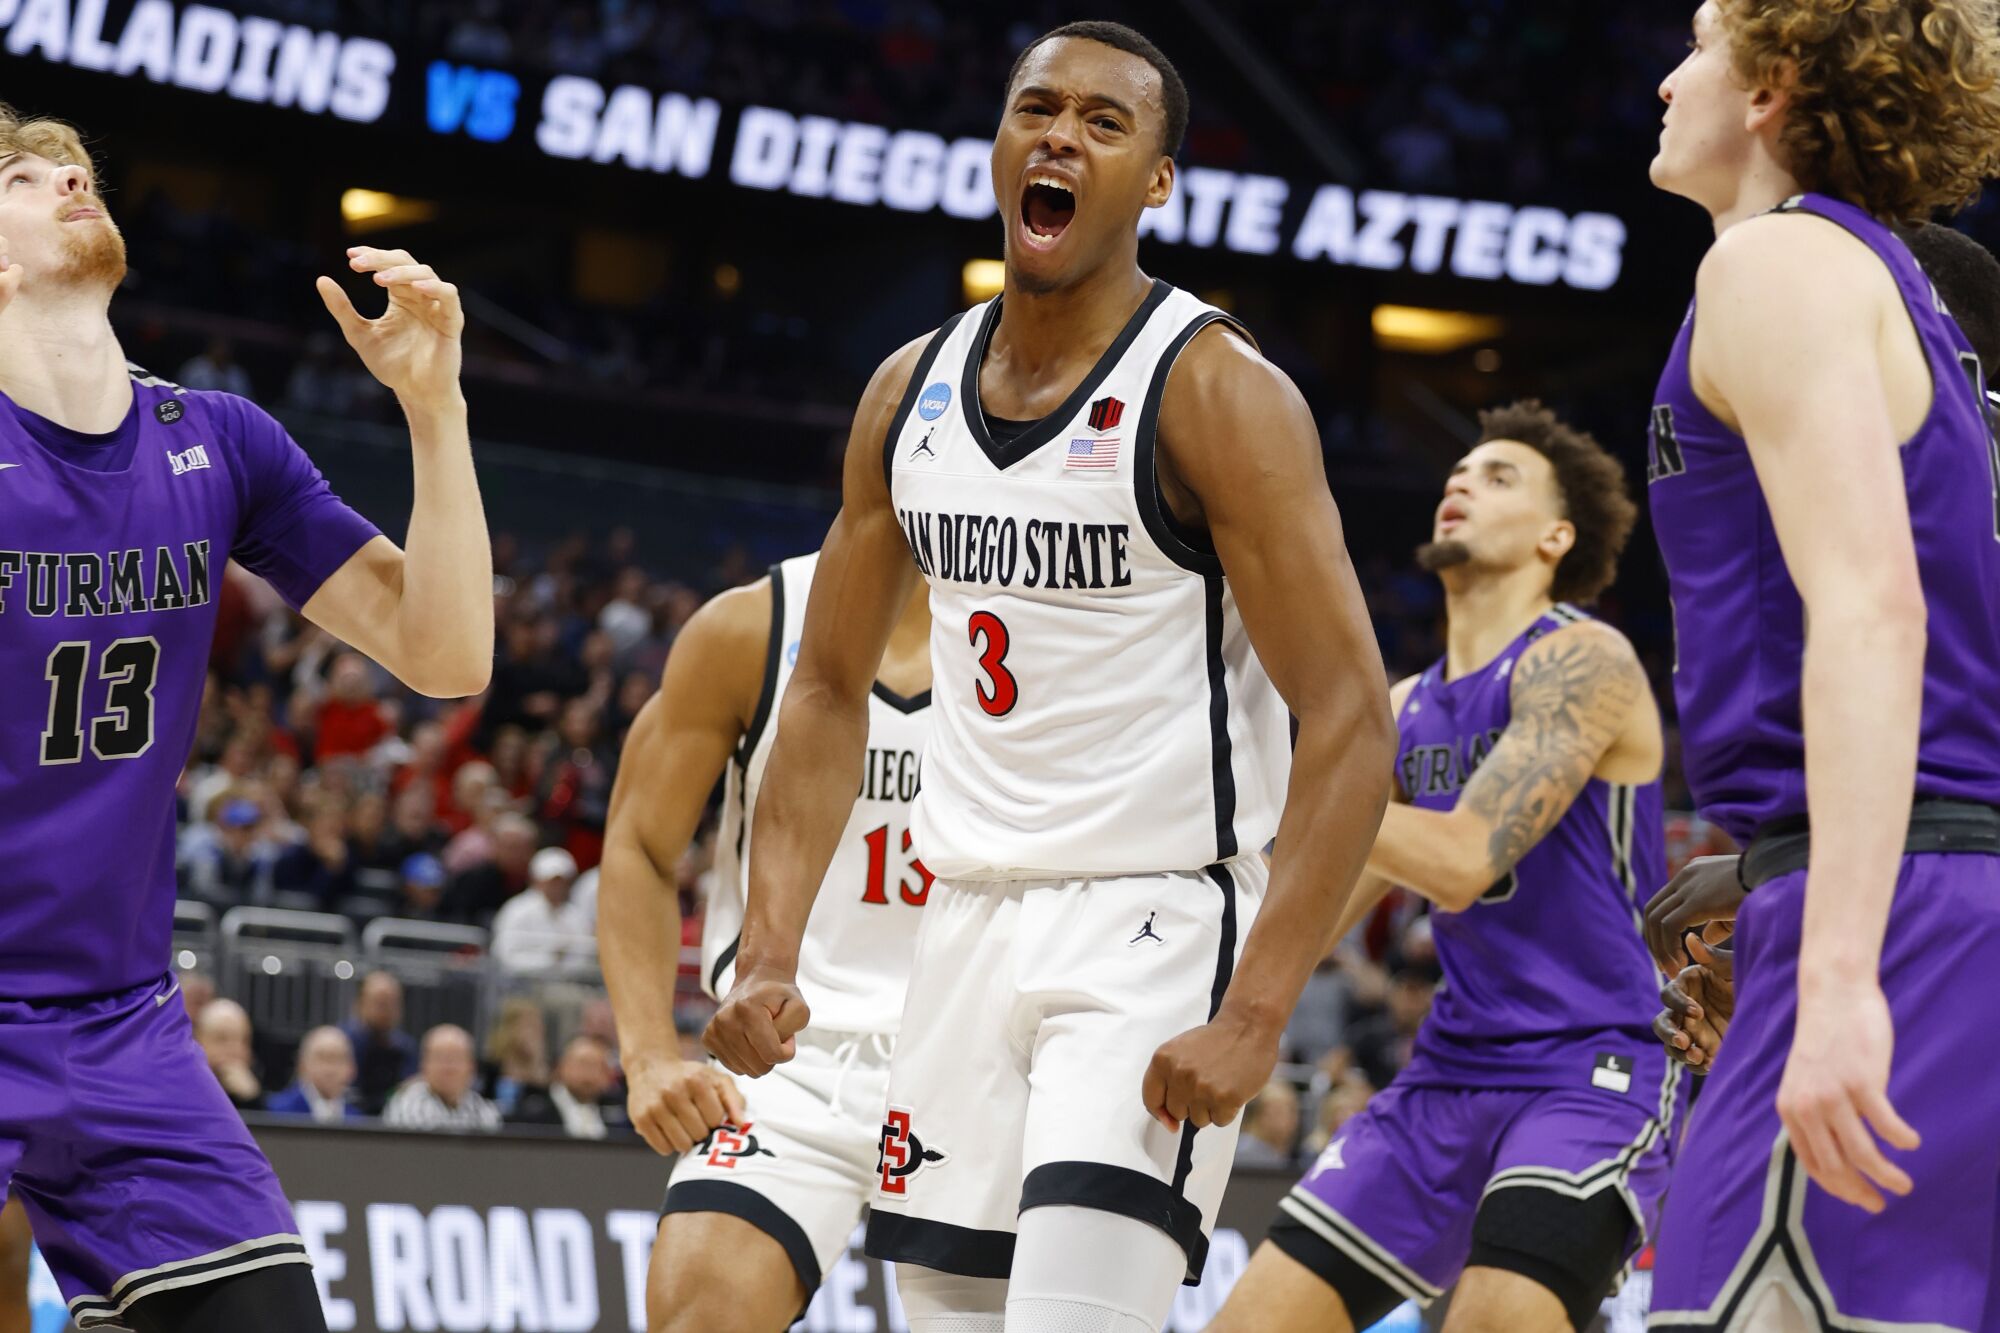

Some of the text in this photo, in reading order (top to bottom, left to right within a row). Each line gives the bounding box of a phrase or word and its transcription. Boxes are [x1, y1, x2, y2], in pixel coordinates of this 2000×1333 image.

[0, 0, 1627, 291] ALADINS VS SAN DIEGO ATE AZTECS
[161, 410, 181, 422] 100
[0, 540, 210, 618] FURMAN
[938, 513, 1018, 587] DIEGO
[1023, 518, 1132, 589] STATE
[38, 635, 161, 767] 13
[968, 610, 1018, 717] 3
[861, 823, 937, 907] 13
[365, 1203, 599, 1333] ROAD
